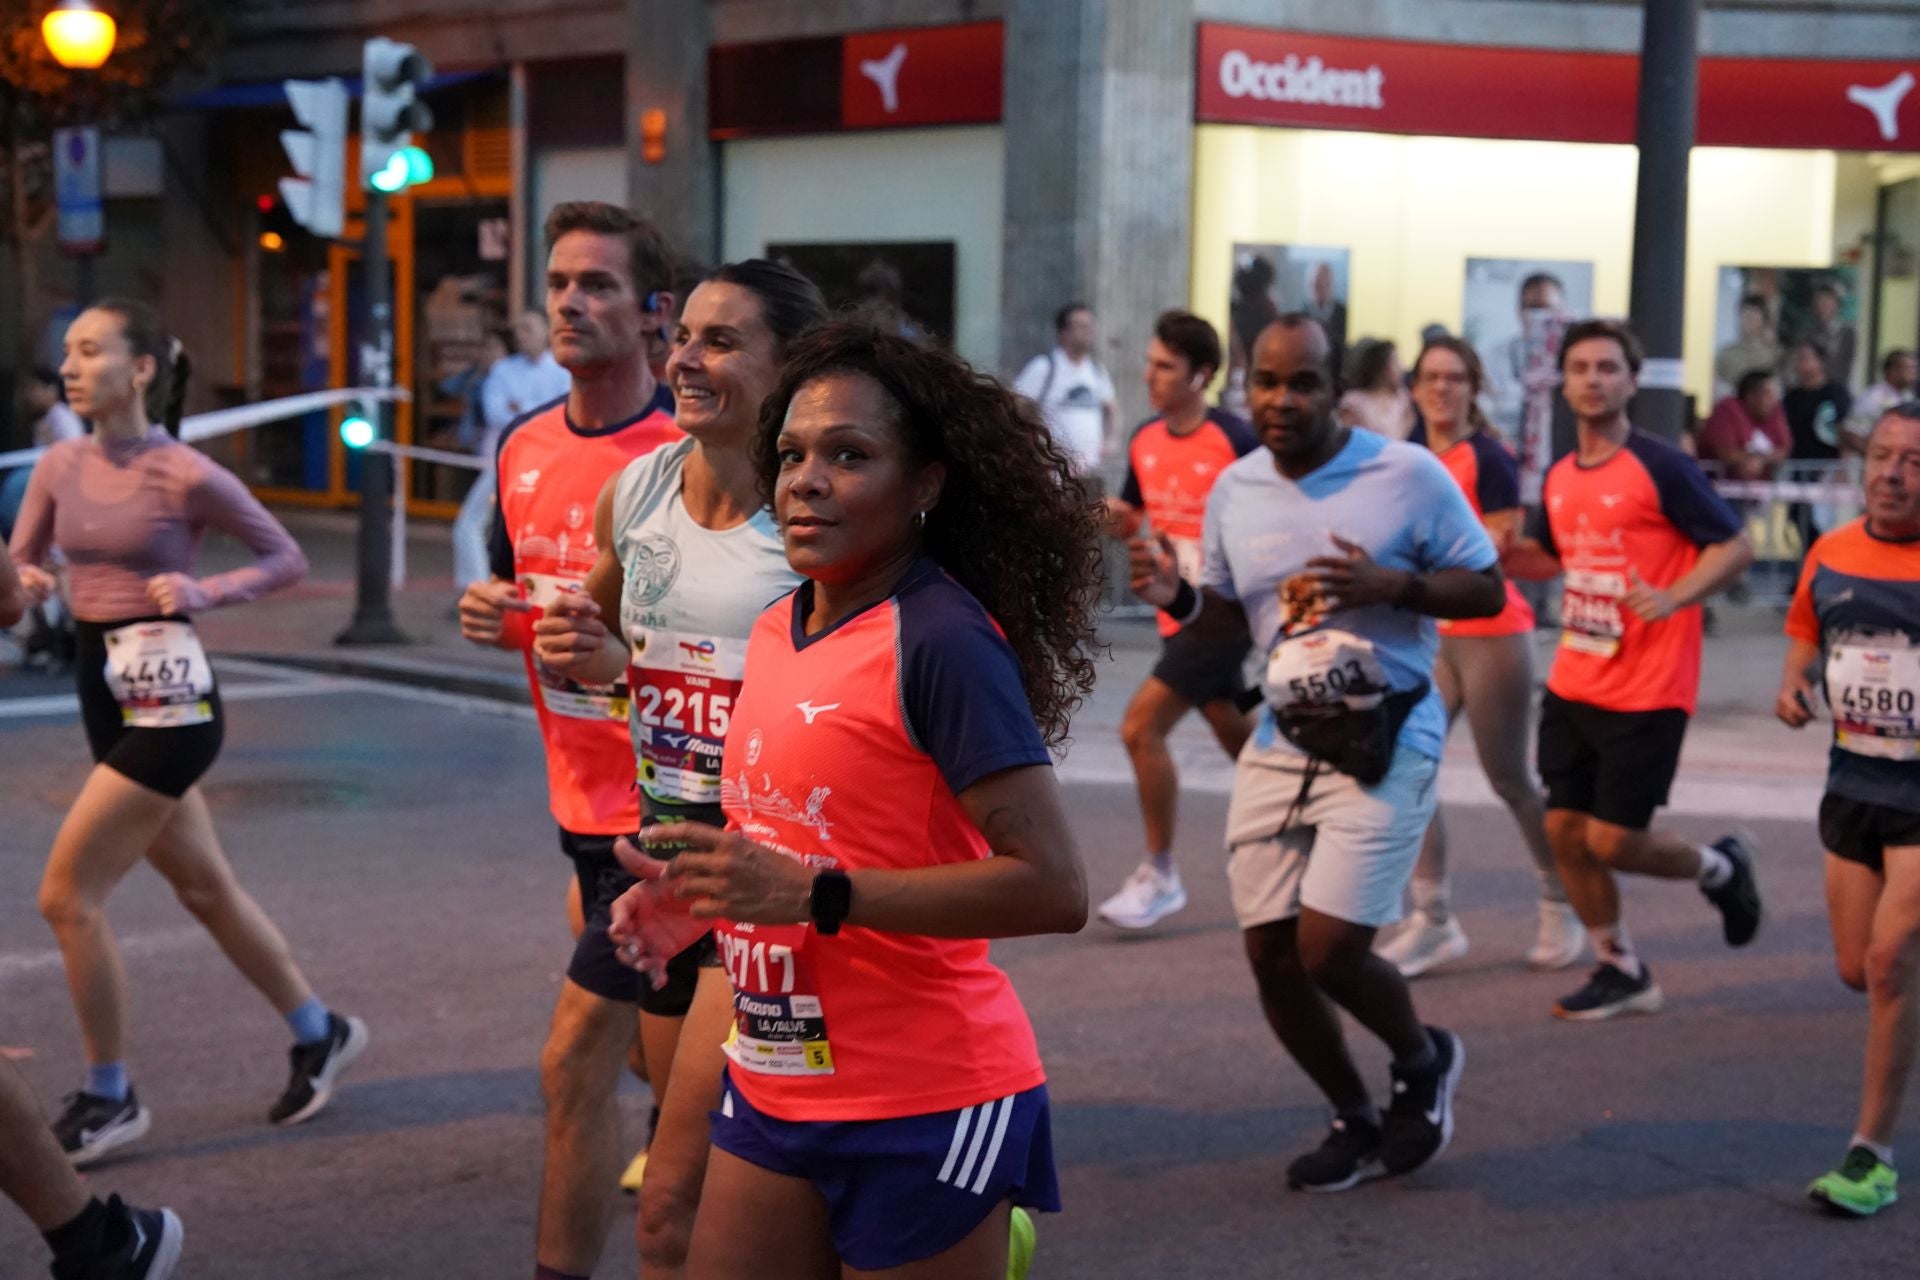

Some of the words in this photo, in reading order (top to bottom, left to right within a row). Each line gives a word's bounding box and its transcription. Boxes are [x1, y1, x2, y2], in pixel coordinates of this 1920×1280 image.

[1220, 50, 1384, 109] Occident
[121, 657, 190, 692] 4467
[685, 675, 711, 688] VANE
[1842, 683, 1914, 714] 4580
[813, 1050, 825, 1065] 5
